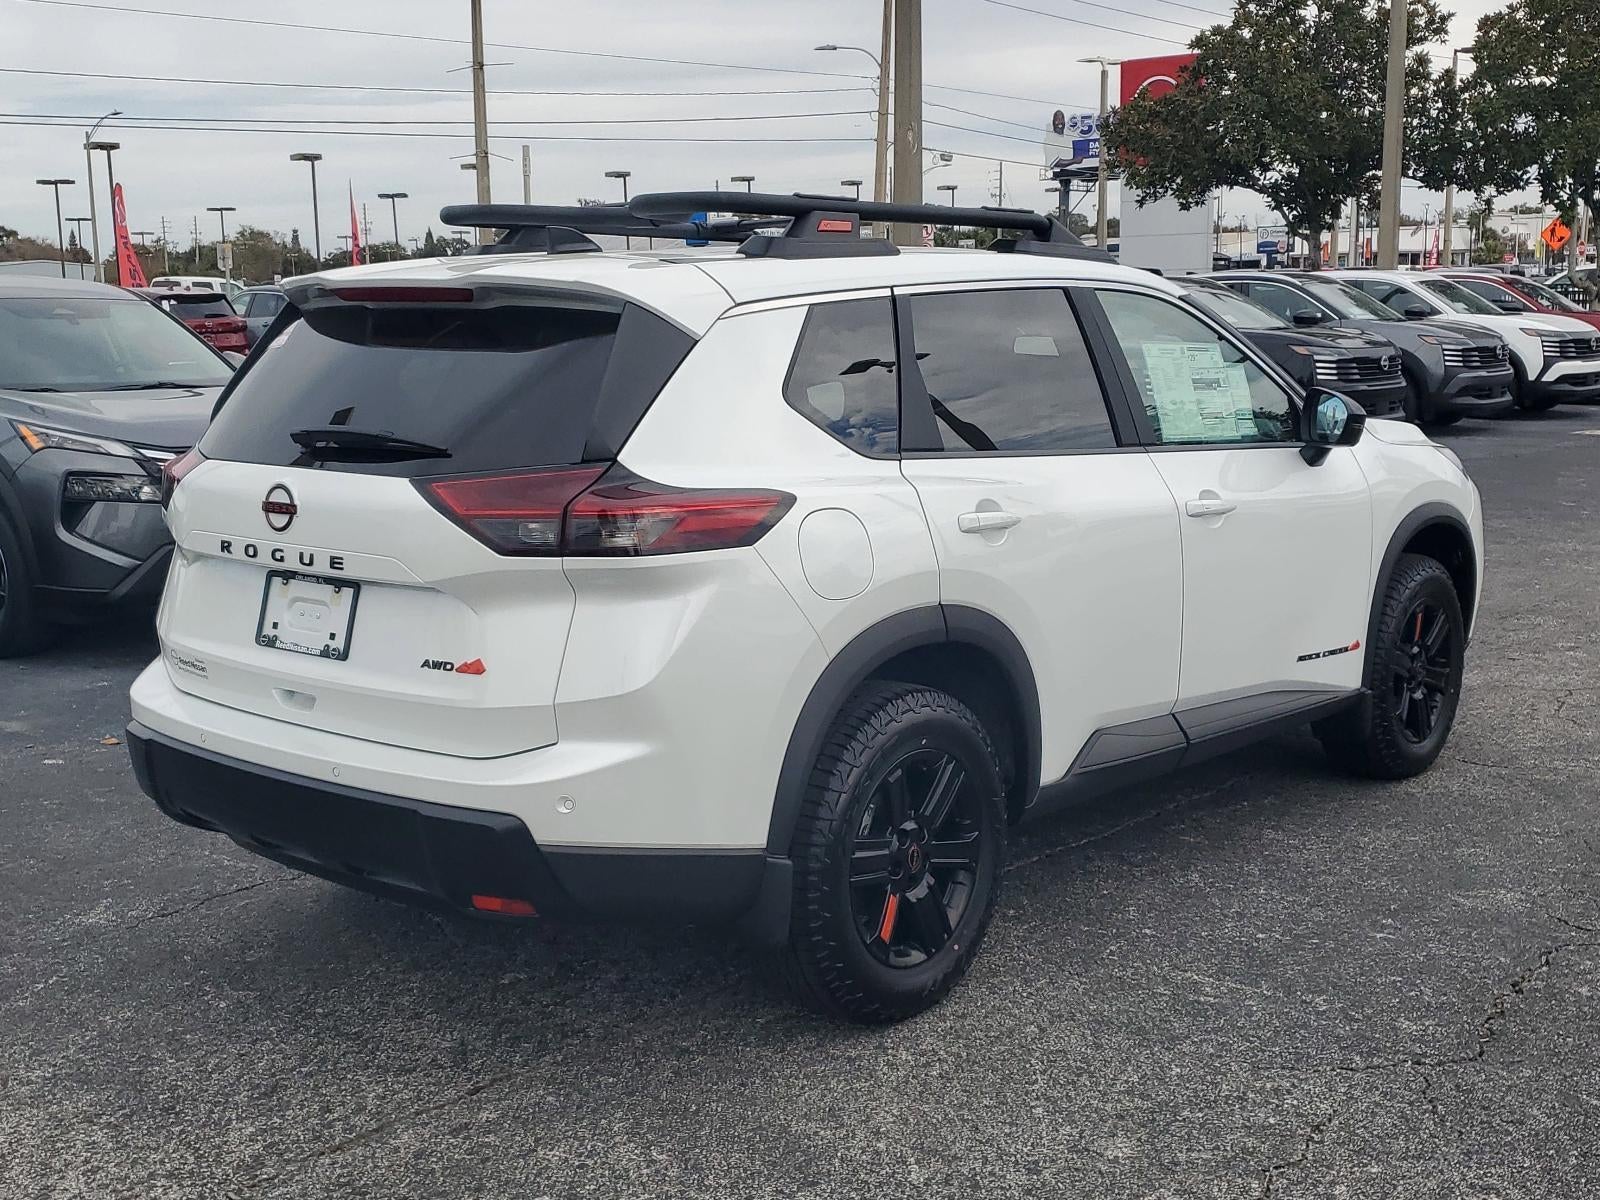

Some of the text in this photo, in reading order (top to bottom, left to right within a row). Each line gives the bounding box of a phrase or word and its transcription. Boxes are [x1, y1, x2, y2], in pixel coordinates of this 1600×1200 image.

[220, 539, 344, 570] ROGUE
[275, 640, 321, 655] ReedNissan.com
[420, 659, 455, 671] AWD
